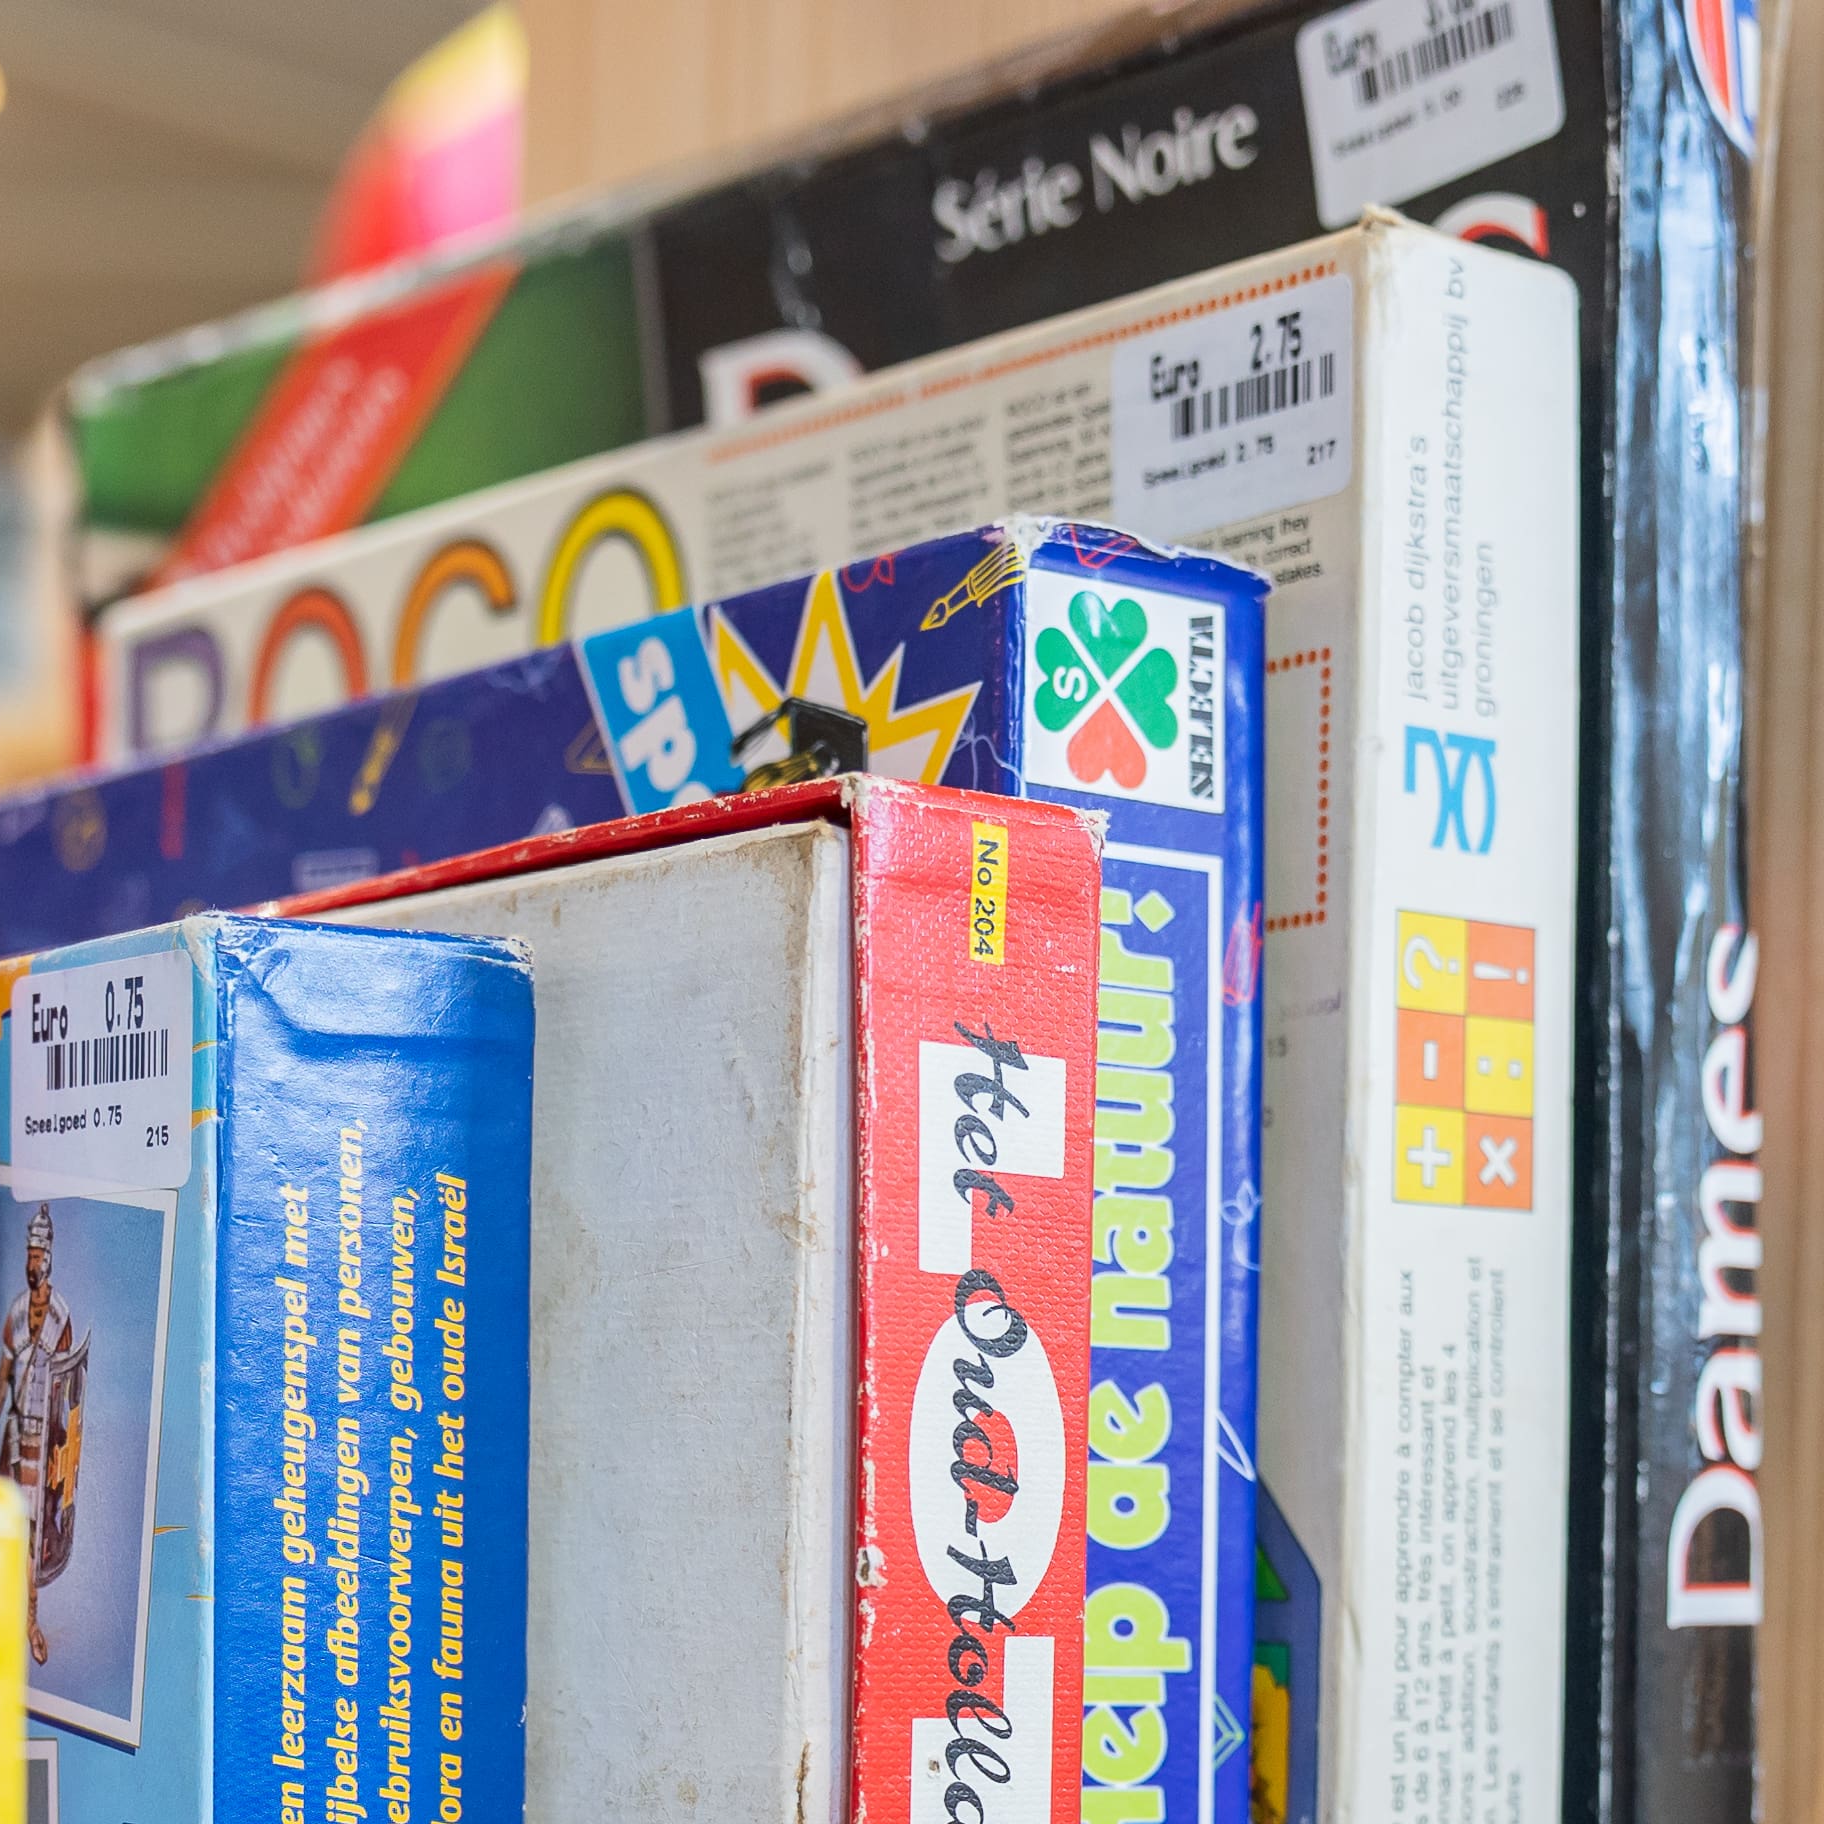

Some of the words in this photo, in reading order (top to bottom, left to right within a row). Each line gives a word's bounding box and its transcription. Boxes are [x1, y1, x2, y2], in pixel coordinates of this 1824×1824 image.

[931, 128, 1082, 265] Série
[1090, 104, 1260, 210] Noire
[1447, 257, 1466, 300] bv
[1151, 356, 1199, 402] Euro
[1250, 312, 1303, 371] 2.75
[1307, 440, 1337, 468] 217
[1405, 435, 1431, 590] dijkstra's
[1276, 562, 1323, 588] stakes.
[1403, 606, 1429, 702] jacob
[1474, 541, 1497, 718] groningen
[1188, 615, 1216, 800] SELECTA
[974, 897, 996, 955] 204
[31, 993, 69, 1043] Euro
[104, 975, 144, 1034] 0.75
[25, 1109, 88, 1137] Speelgoed
[93, 1105, 123, 1129] 0.75
[145, 1126, 170, 1149] 215
[953, 1022, 1029, 1220] Het
[279, 1182, 309, 1266] met
[338, 1118, 371, 1318] personen,
[436, 1171, 467, 1286] Israël
[382, 1187, 422, 1411] gebouwen,
[1397, 1269, 1413, 1315] aux
[1466, 1256, 1481, 1280] et
[1666, 923, 1764, 1630] Dames
[337, 1327, 361, 1402] van
[434, 1297, 466, 1399] oude
[1395, 1327, 1415, 1432] compter
[1419, 1364, 1435, 1388] et
[1441, 1343, 1456, 1358] 4
[1463, 1289, 1483, 1458] multiplication
[274, 1276, 317, 1563] geheugenspel
[1441, 1369, 1456, 1405] les
[433, 1411, 465, 1479] het
[1489, 1408, 1504, 1436] se
[1417, 1398, 1434, 1543] intéressant
[1440, 1416, 1459, 1522] apprend
[1488, 1446, 1504, 1470] et
[327, 1416, 370, 1684] afbeeldingen
[433, 1488, 464, 1546] uit
[1393, 1469, 1412, 1602] apprendre
[1440, 1532, 1455, 1566] on
[432, 1559, 464, 1678] fauna
[1393, 1615, 1411, 1671] pour
[273, 1576, 307, 1768] leerzaam
[1390, 1683, 1411, 1720] jeu
[1435, 1674, 1453, 1731] Petit
[1482, 1640, 1500, 1734] enfants
[439, 1692, 462, 1739] en
[1391, 1730, 1407, 1763] un
[1389, 1773, 1406, 1811] est
[1412, 1771, 1430, 1802] de
[1482, 1745, 1499, 1790] Les
